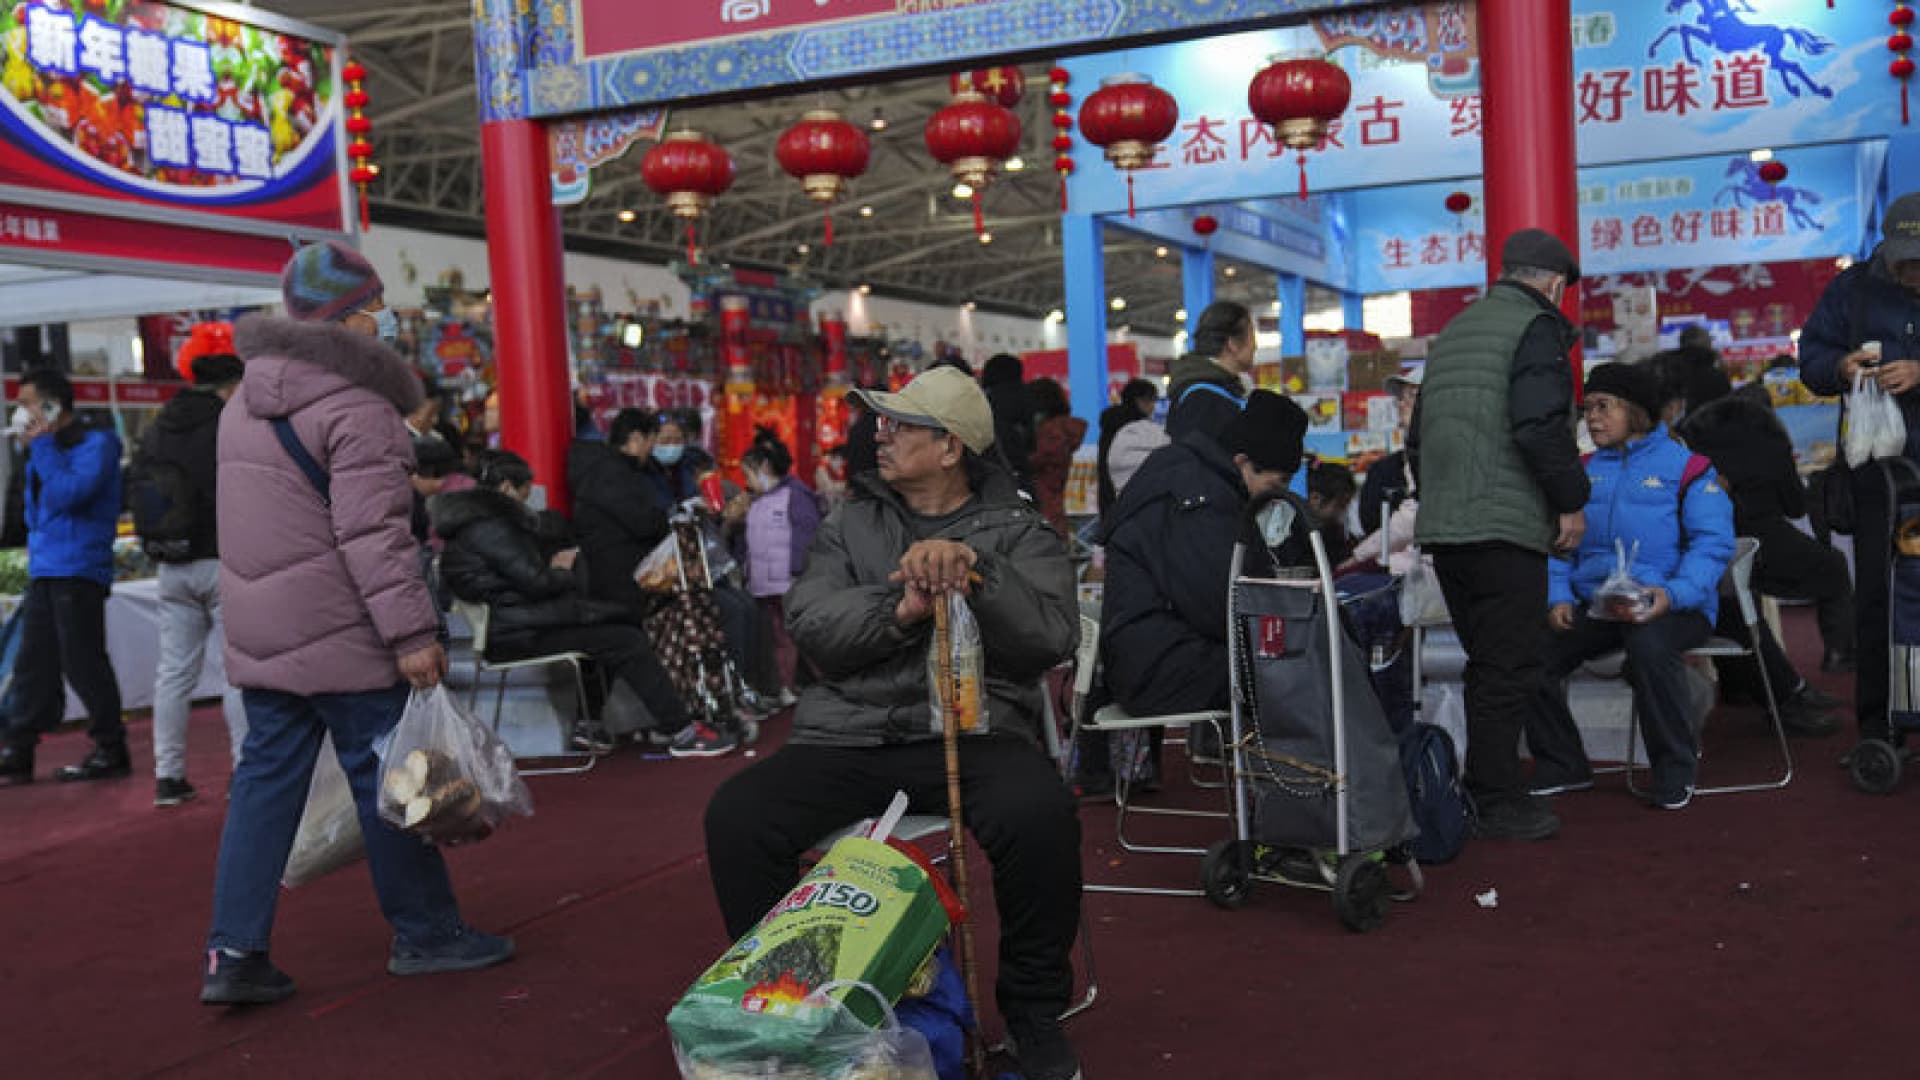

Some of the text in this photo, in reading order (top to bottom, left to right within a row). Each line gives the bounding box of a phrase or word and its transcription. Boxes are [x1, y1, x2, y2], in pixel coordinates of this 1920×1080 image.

[1141, 95, 1404, 170] 态内古
[1578, 54, 1769, 124] 好味道
[1591, 203, 1786, 251] 绿色好味道
